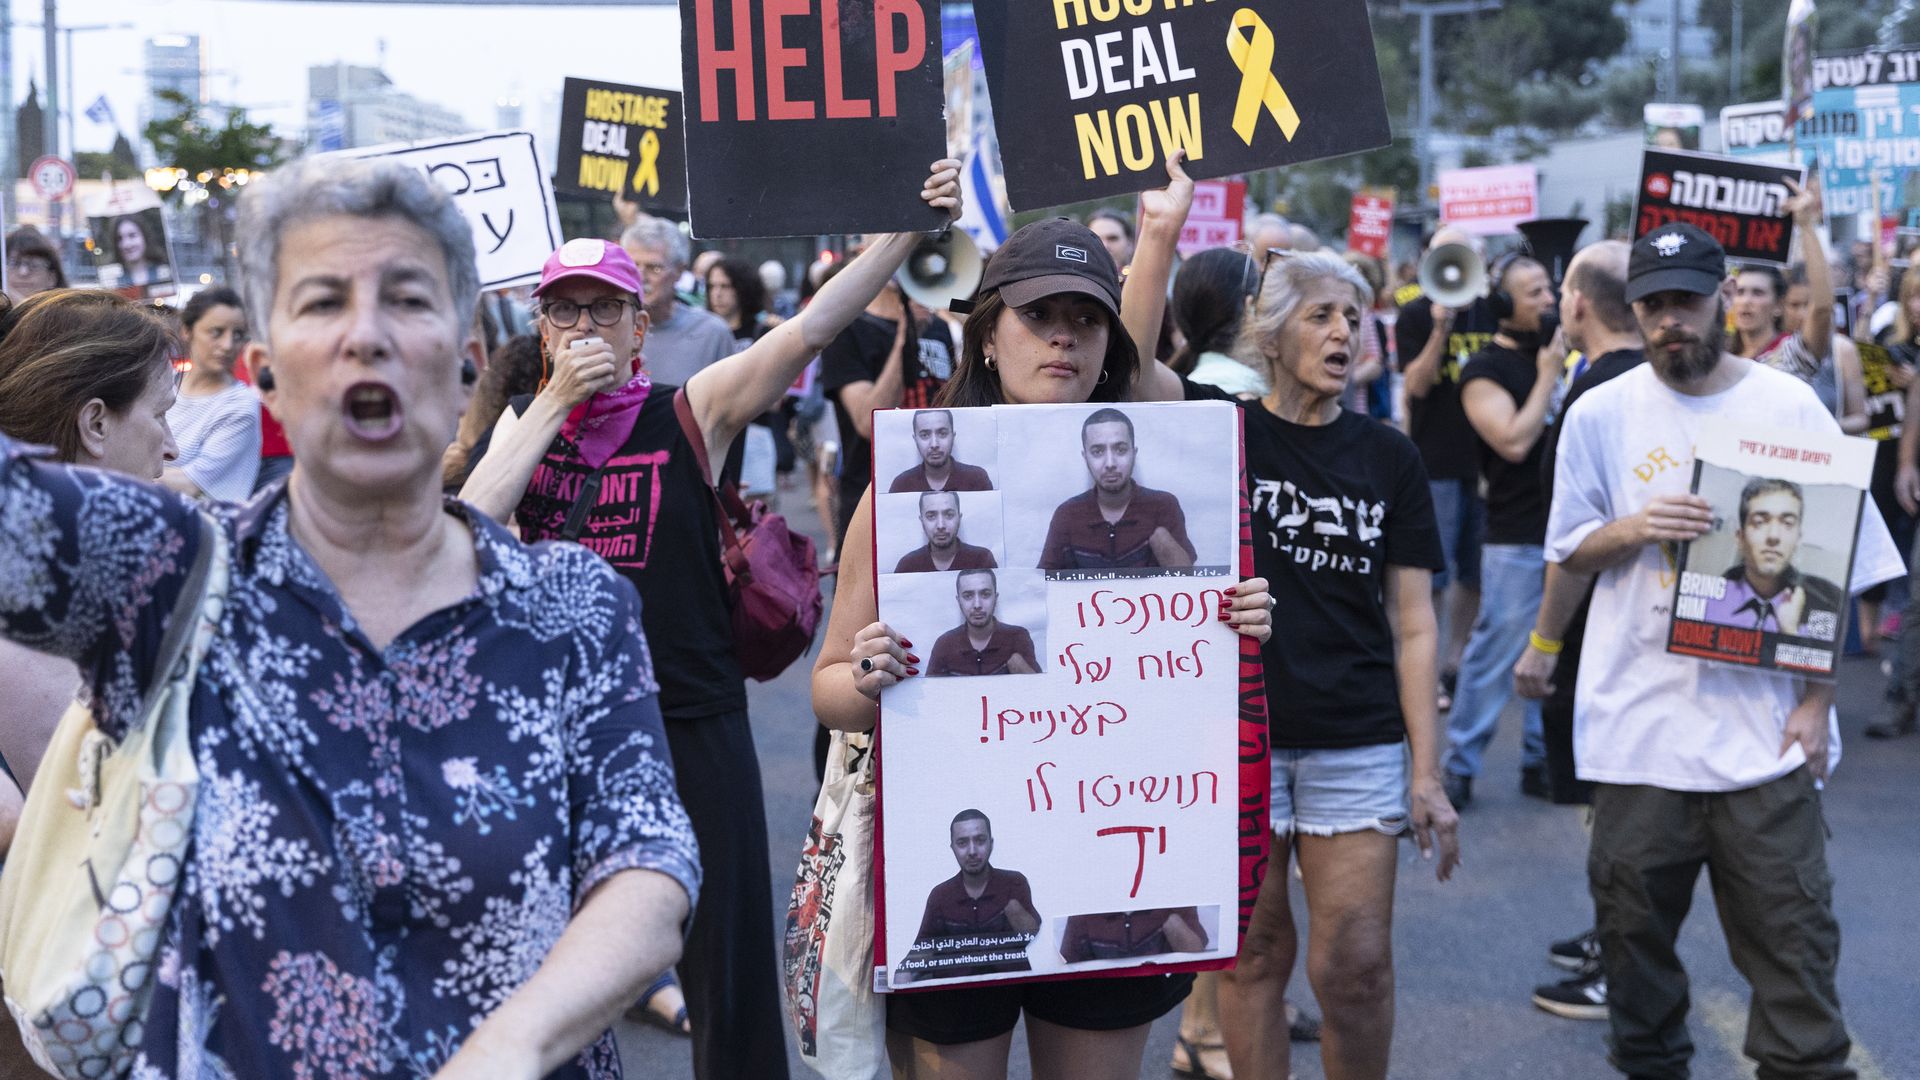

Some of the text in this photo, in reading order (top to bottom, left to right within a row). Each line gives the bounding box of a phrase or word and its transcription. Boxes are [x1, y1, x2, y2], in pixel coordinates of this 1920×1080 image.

[695, 0, 926, 122] HELP
[1060, 21, 1196, 100] DEAL
[585, 88, 669, 129] HOSTAGE
[582, 120, 630, 157] DEAL
[1074, 92, 1204, 180] NOW
[578, 154, 629, 192] NOW
[1670, 170, 1789, 218] השבתה
[1745, 218, 1783, 252] או
[1679, 571, 1728, 600] BRING
[1077, 588, 1226, 634] תסתכלו
[1675, 595, 1706, 621] HIM
[1673, 620, 1763, 656] HOME NOW!
[1059, 639, 1211, 684] לאח שלי
[980, 695, 1128, 743] בעיניים!
[1026, 761, 1218, 813] תושיטו לו
[1096, 826, 1167, 898] יד
[936, 939, 954, 951] الذي
[955, 937, 978, 949] العلاج
[979, 937, 998, 947] بدون
[1000, 933, 1023, 944] شمس
[906, 960, 928, 969] food,
[928, 959, 938, 967] or
[938, 957, 954, 966] sun
[954, 953, 988, 964] without
[988, 952, 1003, 961] the
